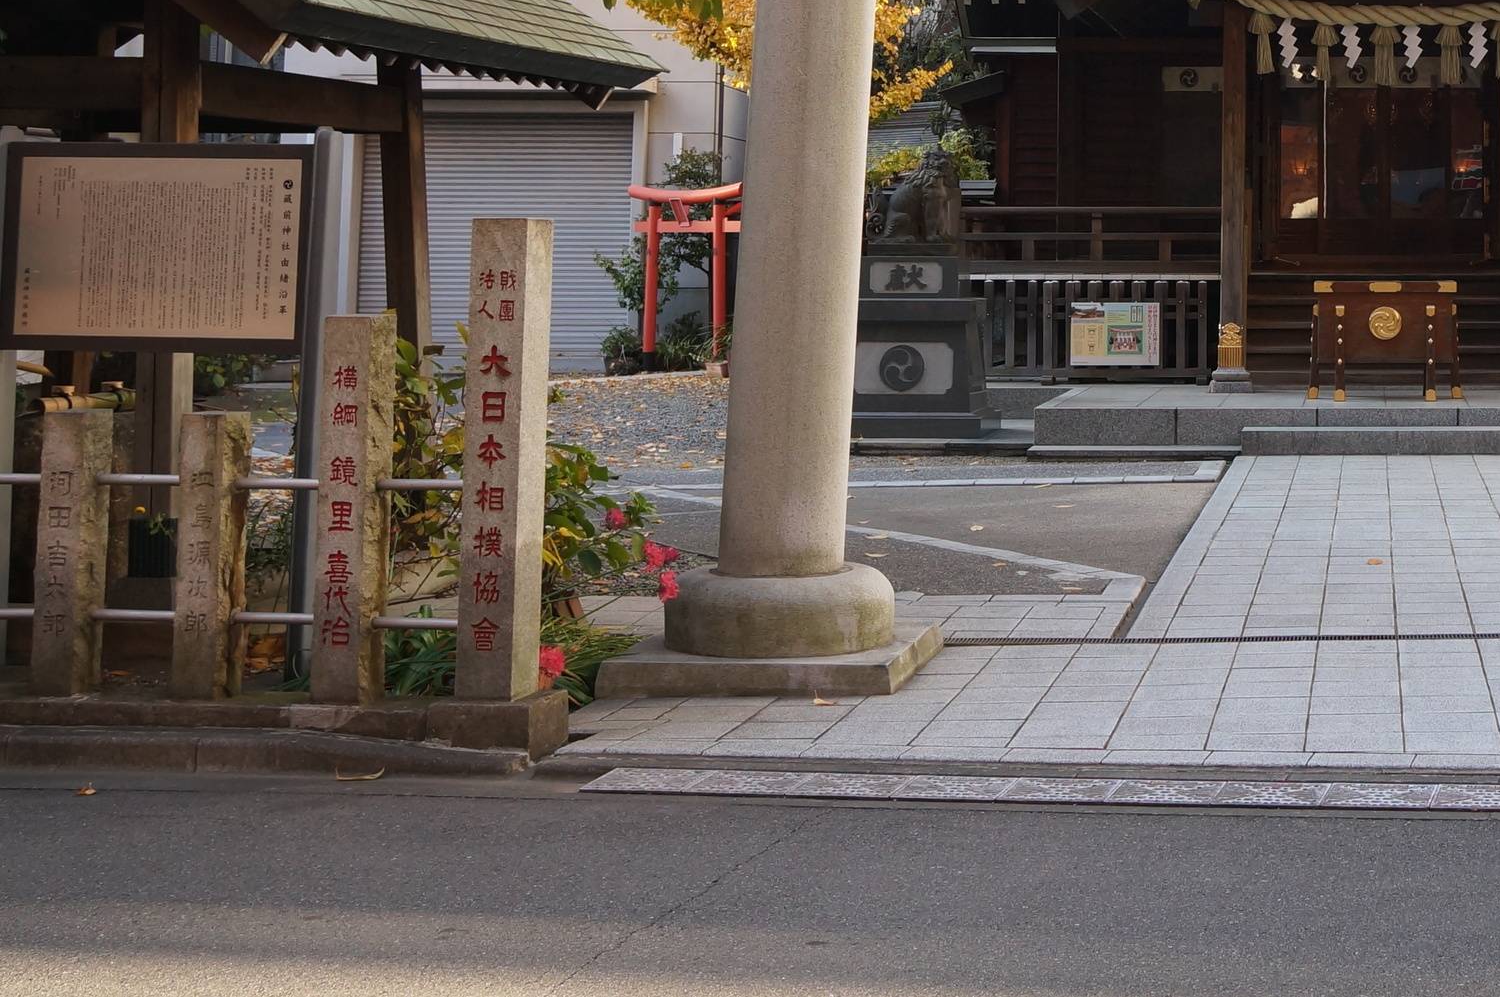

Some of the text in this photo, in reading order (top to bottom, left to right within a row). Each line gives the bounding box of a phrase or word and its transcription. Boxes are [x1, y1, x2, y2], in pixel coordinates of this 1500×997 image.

[477, 268, 496, 319] 法人
[471, 344, 513, 652] 大日本相撲協會
